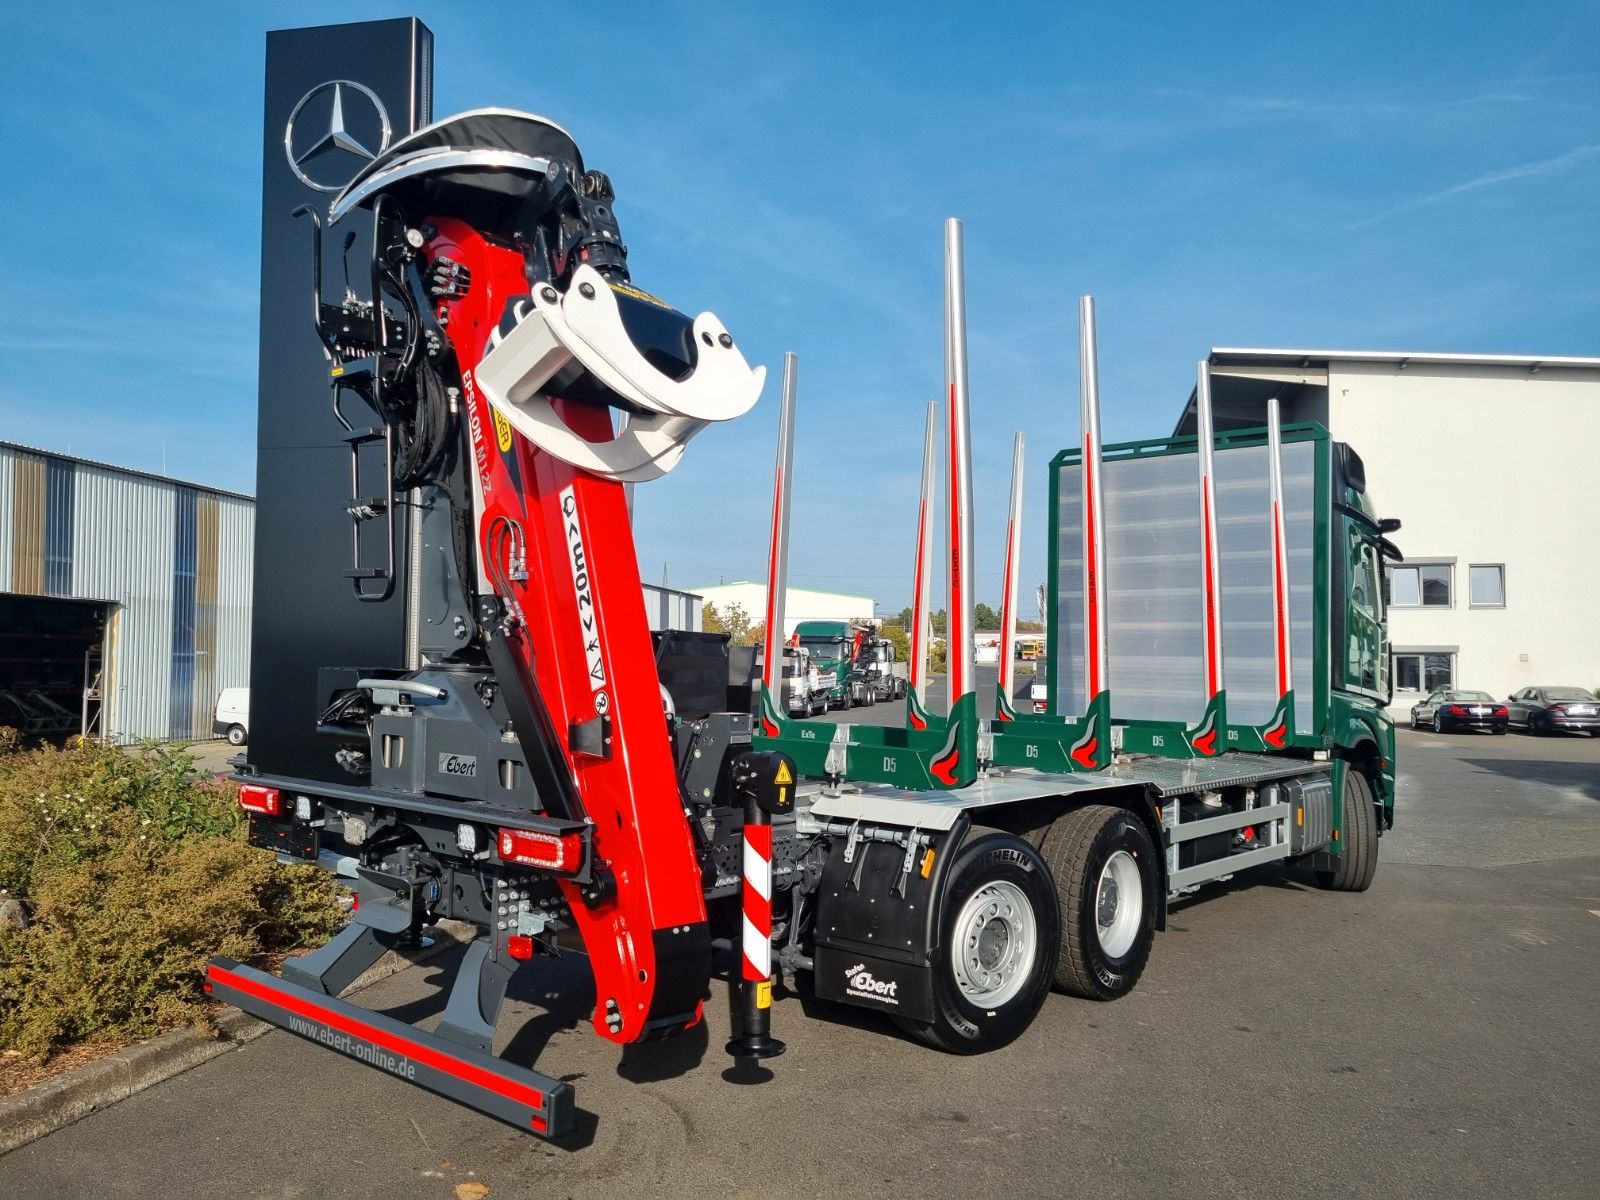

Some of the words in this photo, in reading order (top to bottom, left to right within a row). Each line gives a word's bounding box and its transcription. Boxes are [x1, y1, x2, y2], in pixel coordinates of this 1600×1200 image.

[463, 369, 483, 443] EPSILON
[476, 445, 492, 496] M12Z
[1152, 735, 1164, 747] D5
[1228, 730, 1239, 741] D5
[1026, 744, 1039, 758] D5
[447, 756, 475, 775] Ebert
[883, 756, 896, 772] D5
[851, 972, 897, 997] Ebert
[289, 1015, 416, 1080] www.ebert-online.de
